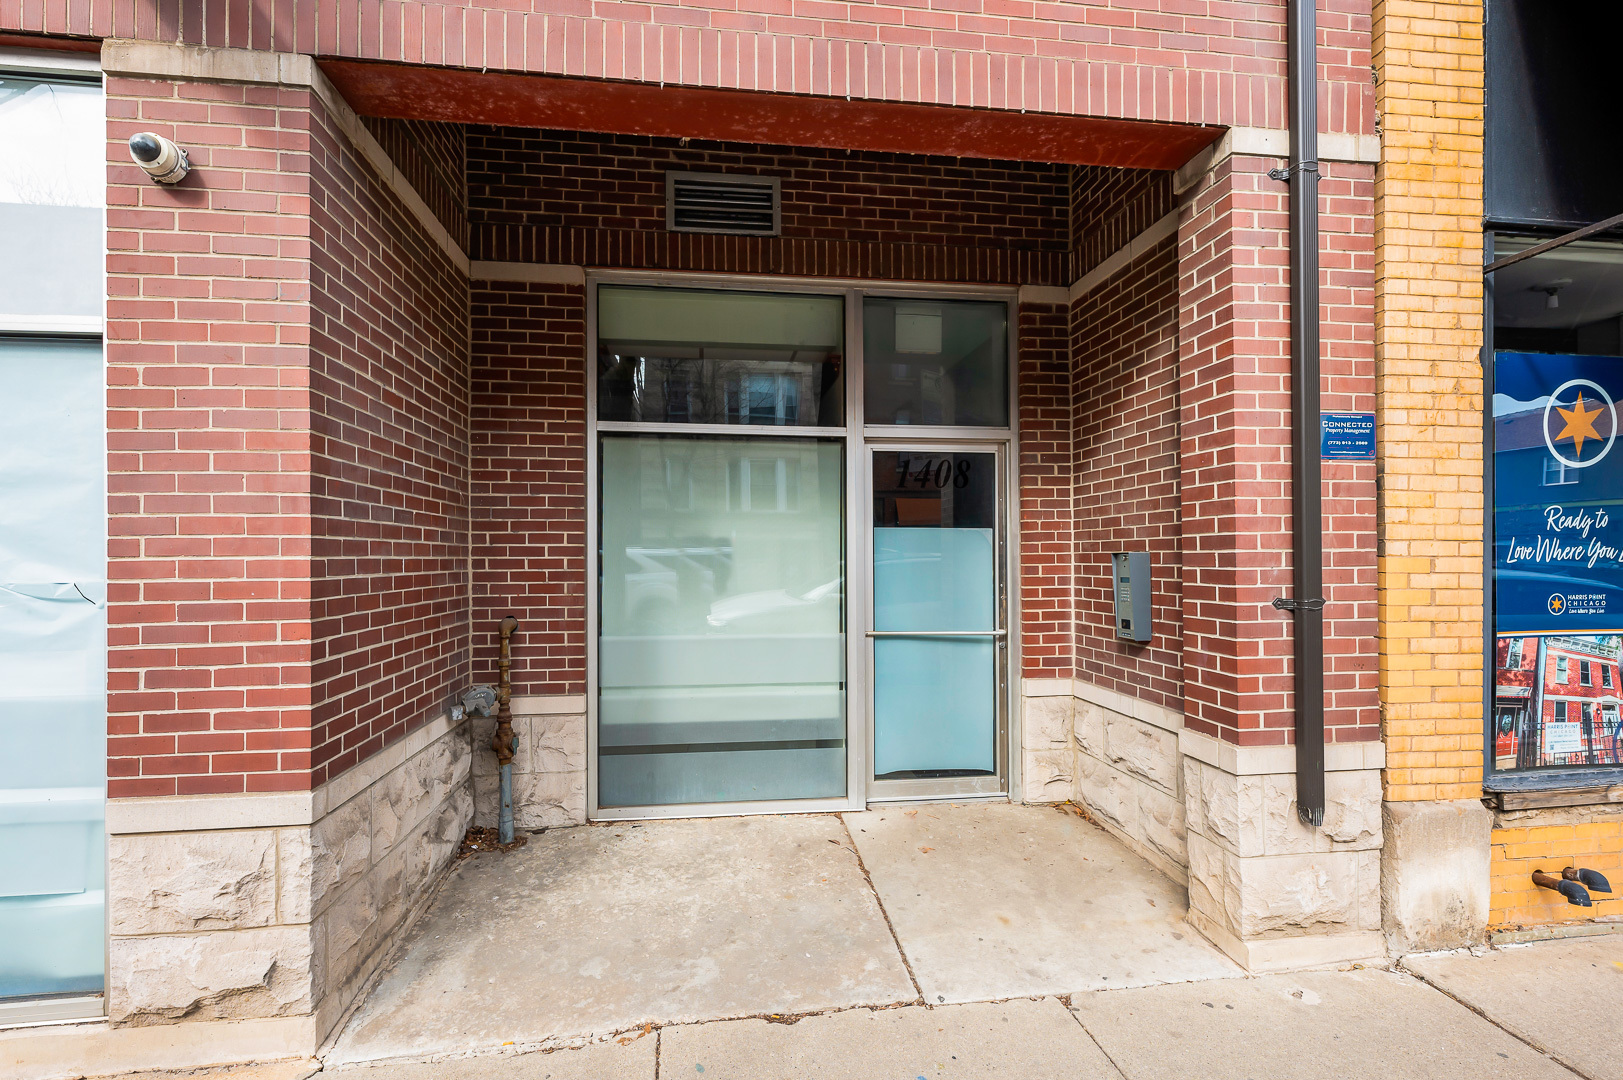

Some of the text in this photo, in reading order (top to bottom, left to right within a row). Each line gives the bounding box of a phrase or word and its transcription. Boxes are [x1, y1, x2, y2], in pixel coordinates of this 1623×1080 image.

[1322, 420, 1373, 428] CONNECTED
[896, 459, 971, 489] 1408
[1544, 505, 1609, 538] Ready to
[1506, 536, 1535, 563] Love
[1536, 535, 1585, 562] Where
[1587, 537, 1618, 568] You
